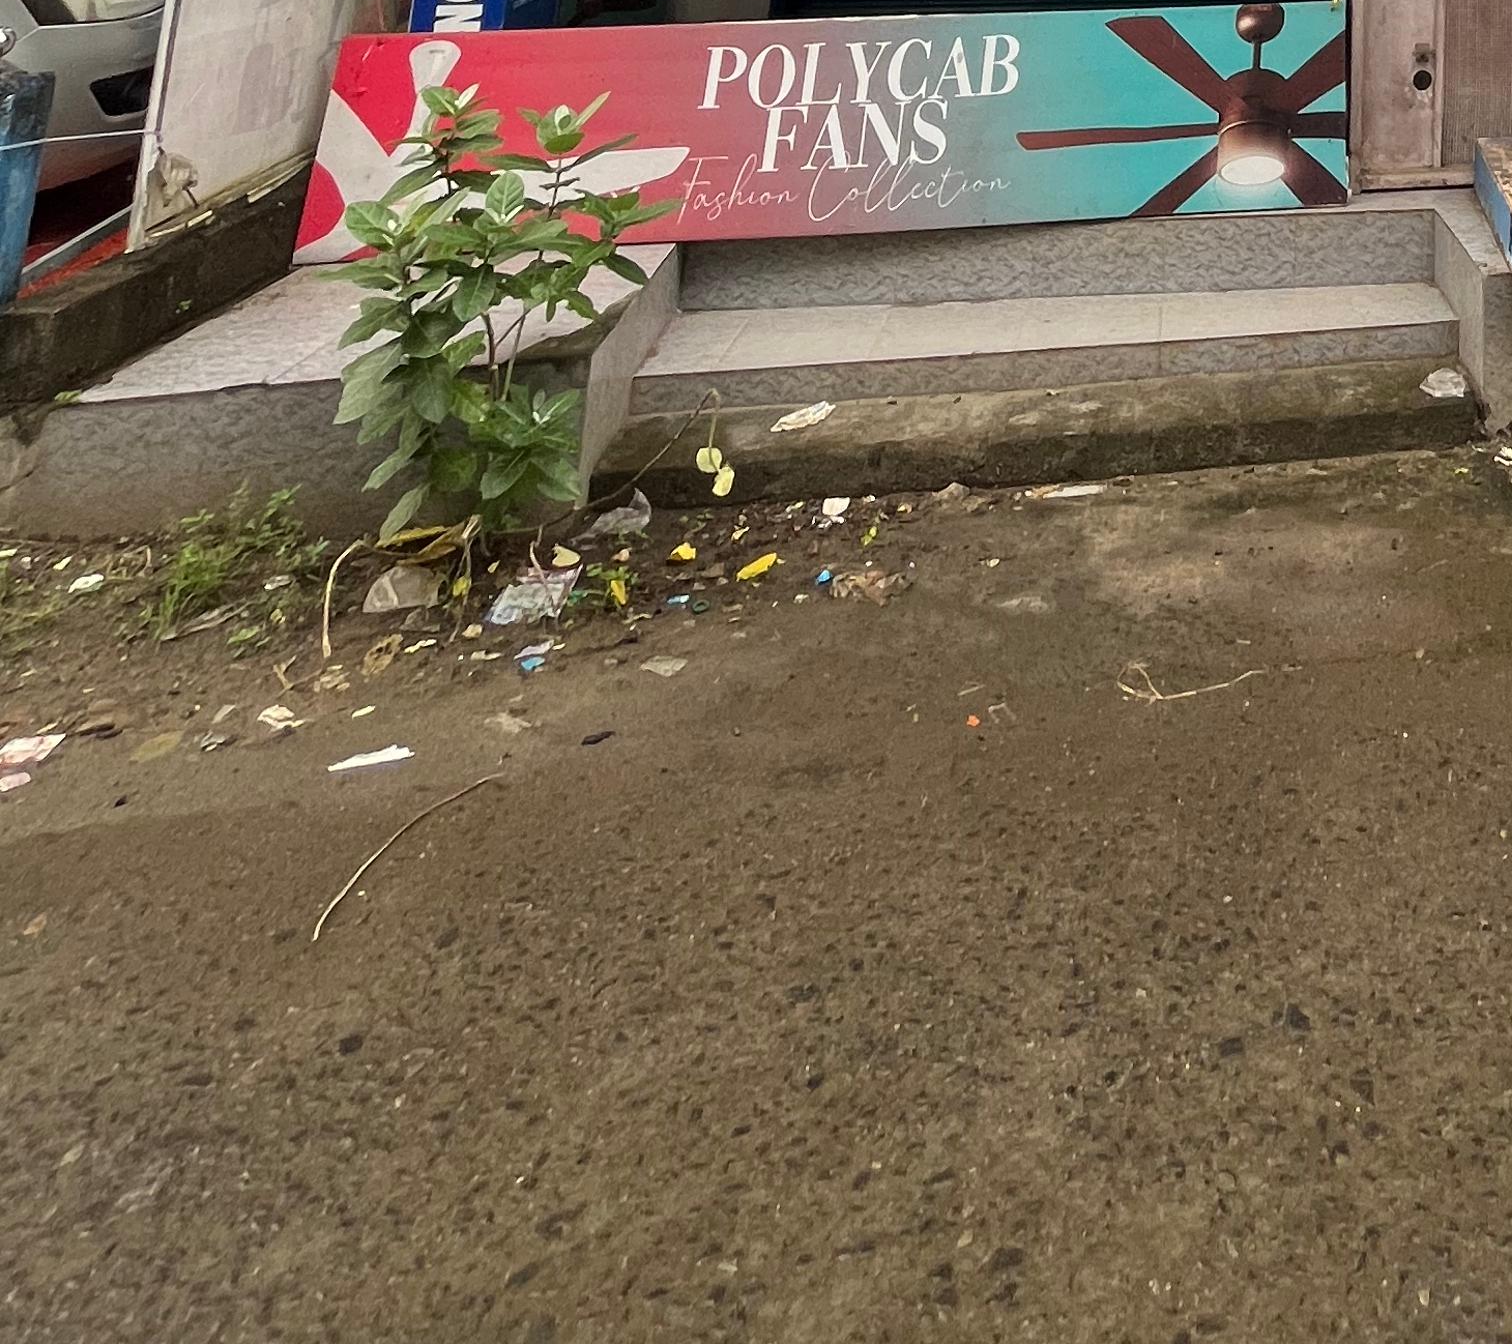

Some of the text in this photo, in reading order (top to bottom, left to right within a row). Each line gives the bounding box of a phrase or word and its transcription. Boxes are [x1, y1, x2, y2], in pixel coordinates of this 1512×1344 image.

[697, 34, 1021, 110] POLYCAB
[757, 99, 949, 173] FANS
[676, 150, 1013, 225] Fashion Collection
